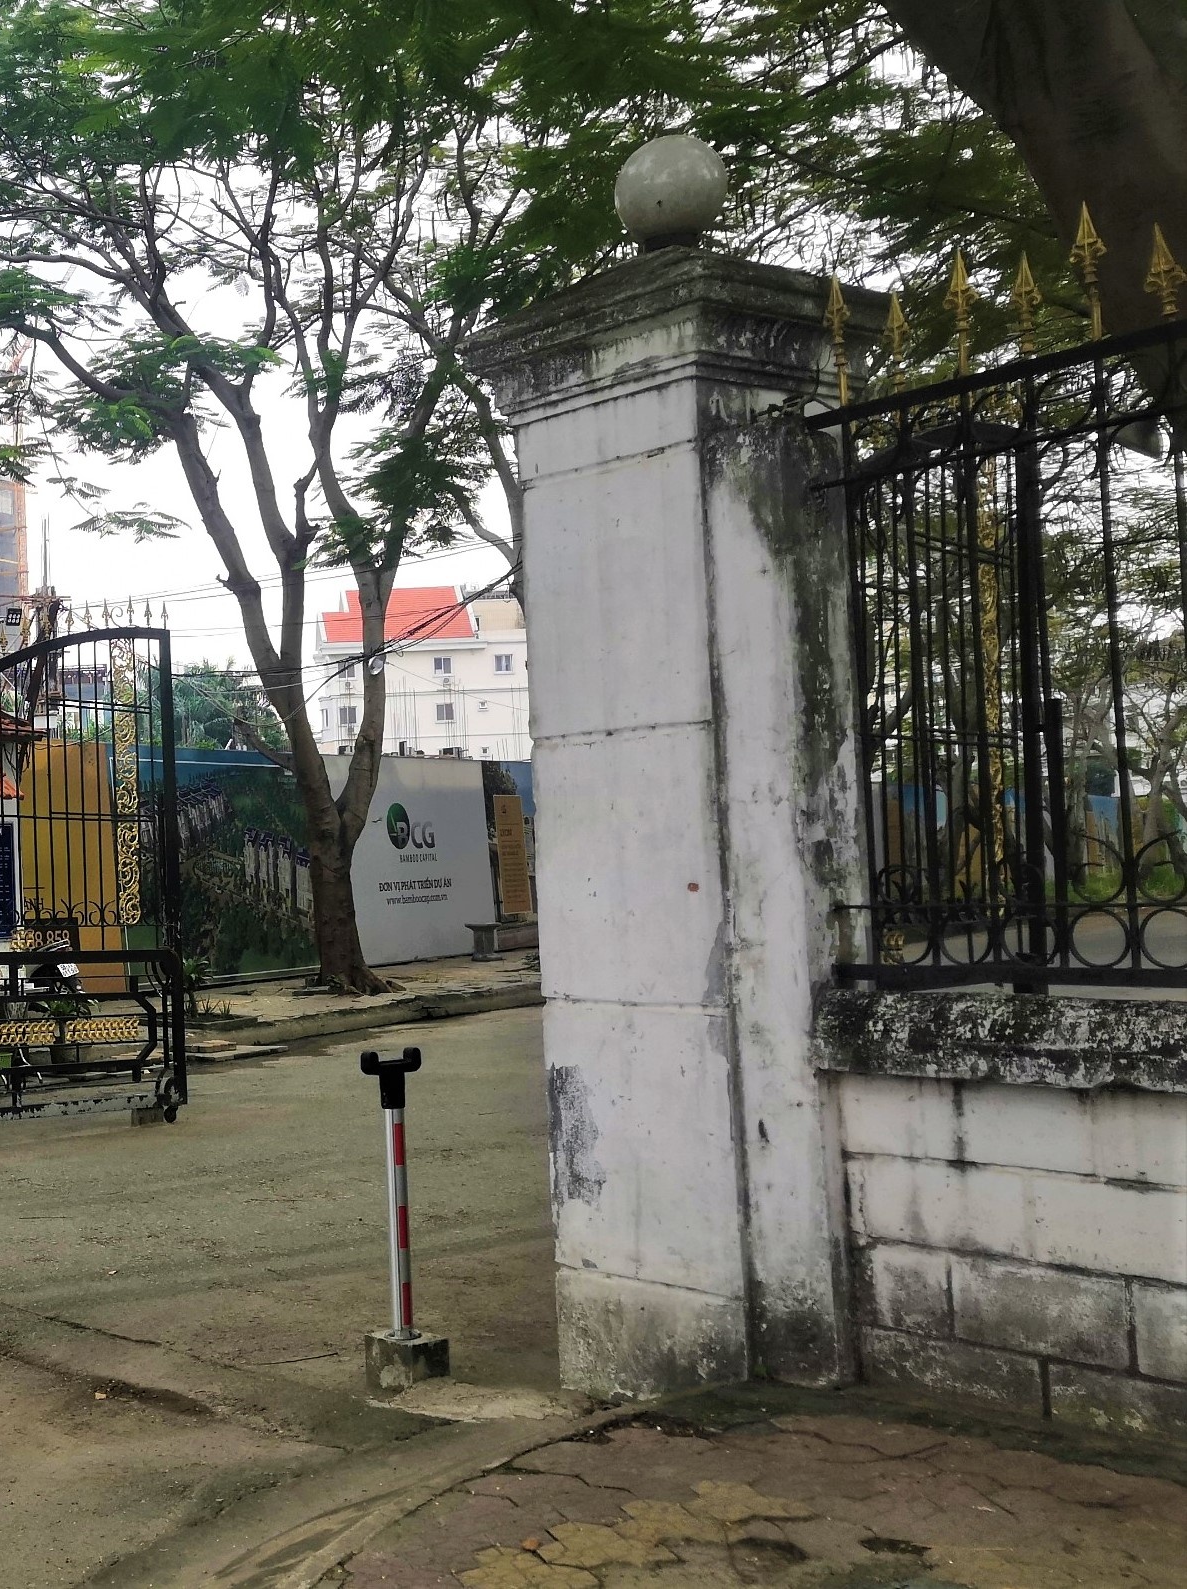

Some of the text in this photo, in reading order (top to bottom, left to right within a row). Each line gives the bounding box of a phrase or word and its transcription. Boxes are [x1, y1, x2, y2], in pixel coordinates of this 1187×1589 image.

[399, 853, 438, 863] BAMBOO CAPITAL
[378, 882, 393, 892] ĐƠN
[393, 881, 401, 892] VỊ
[400, 879, 416, 891] PHÁT
[415, 876, 434, 890] TRIỂN
